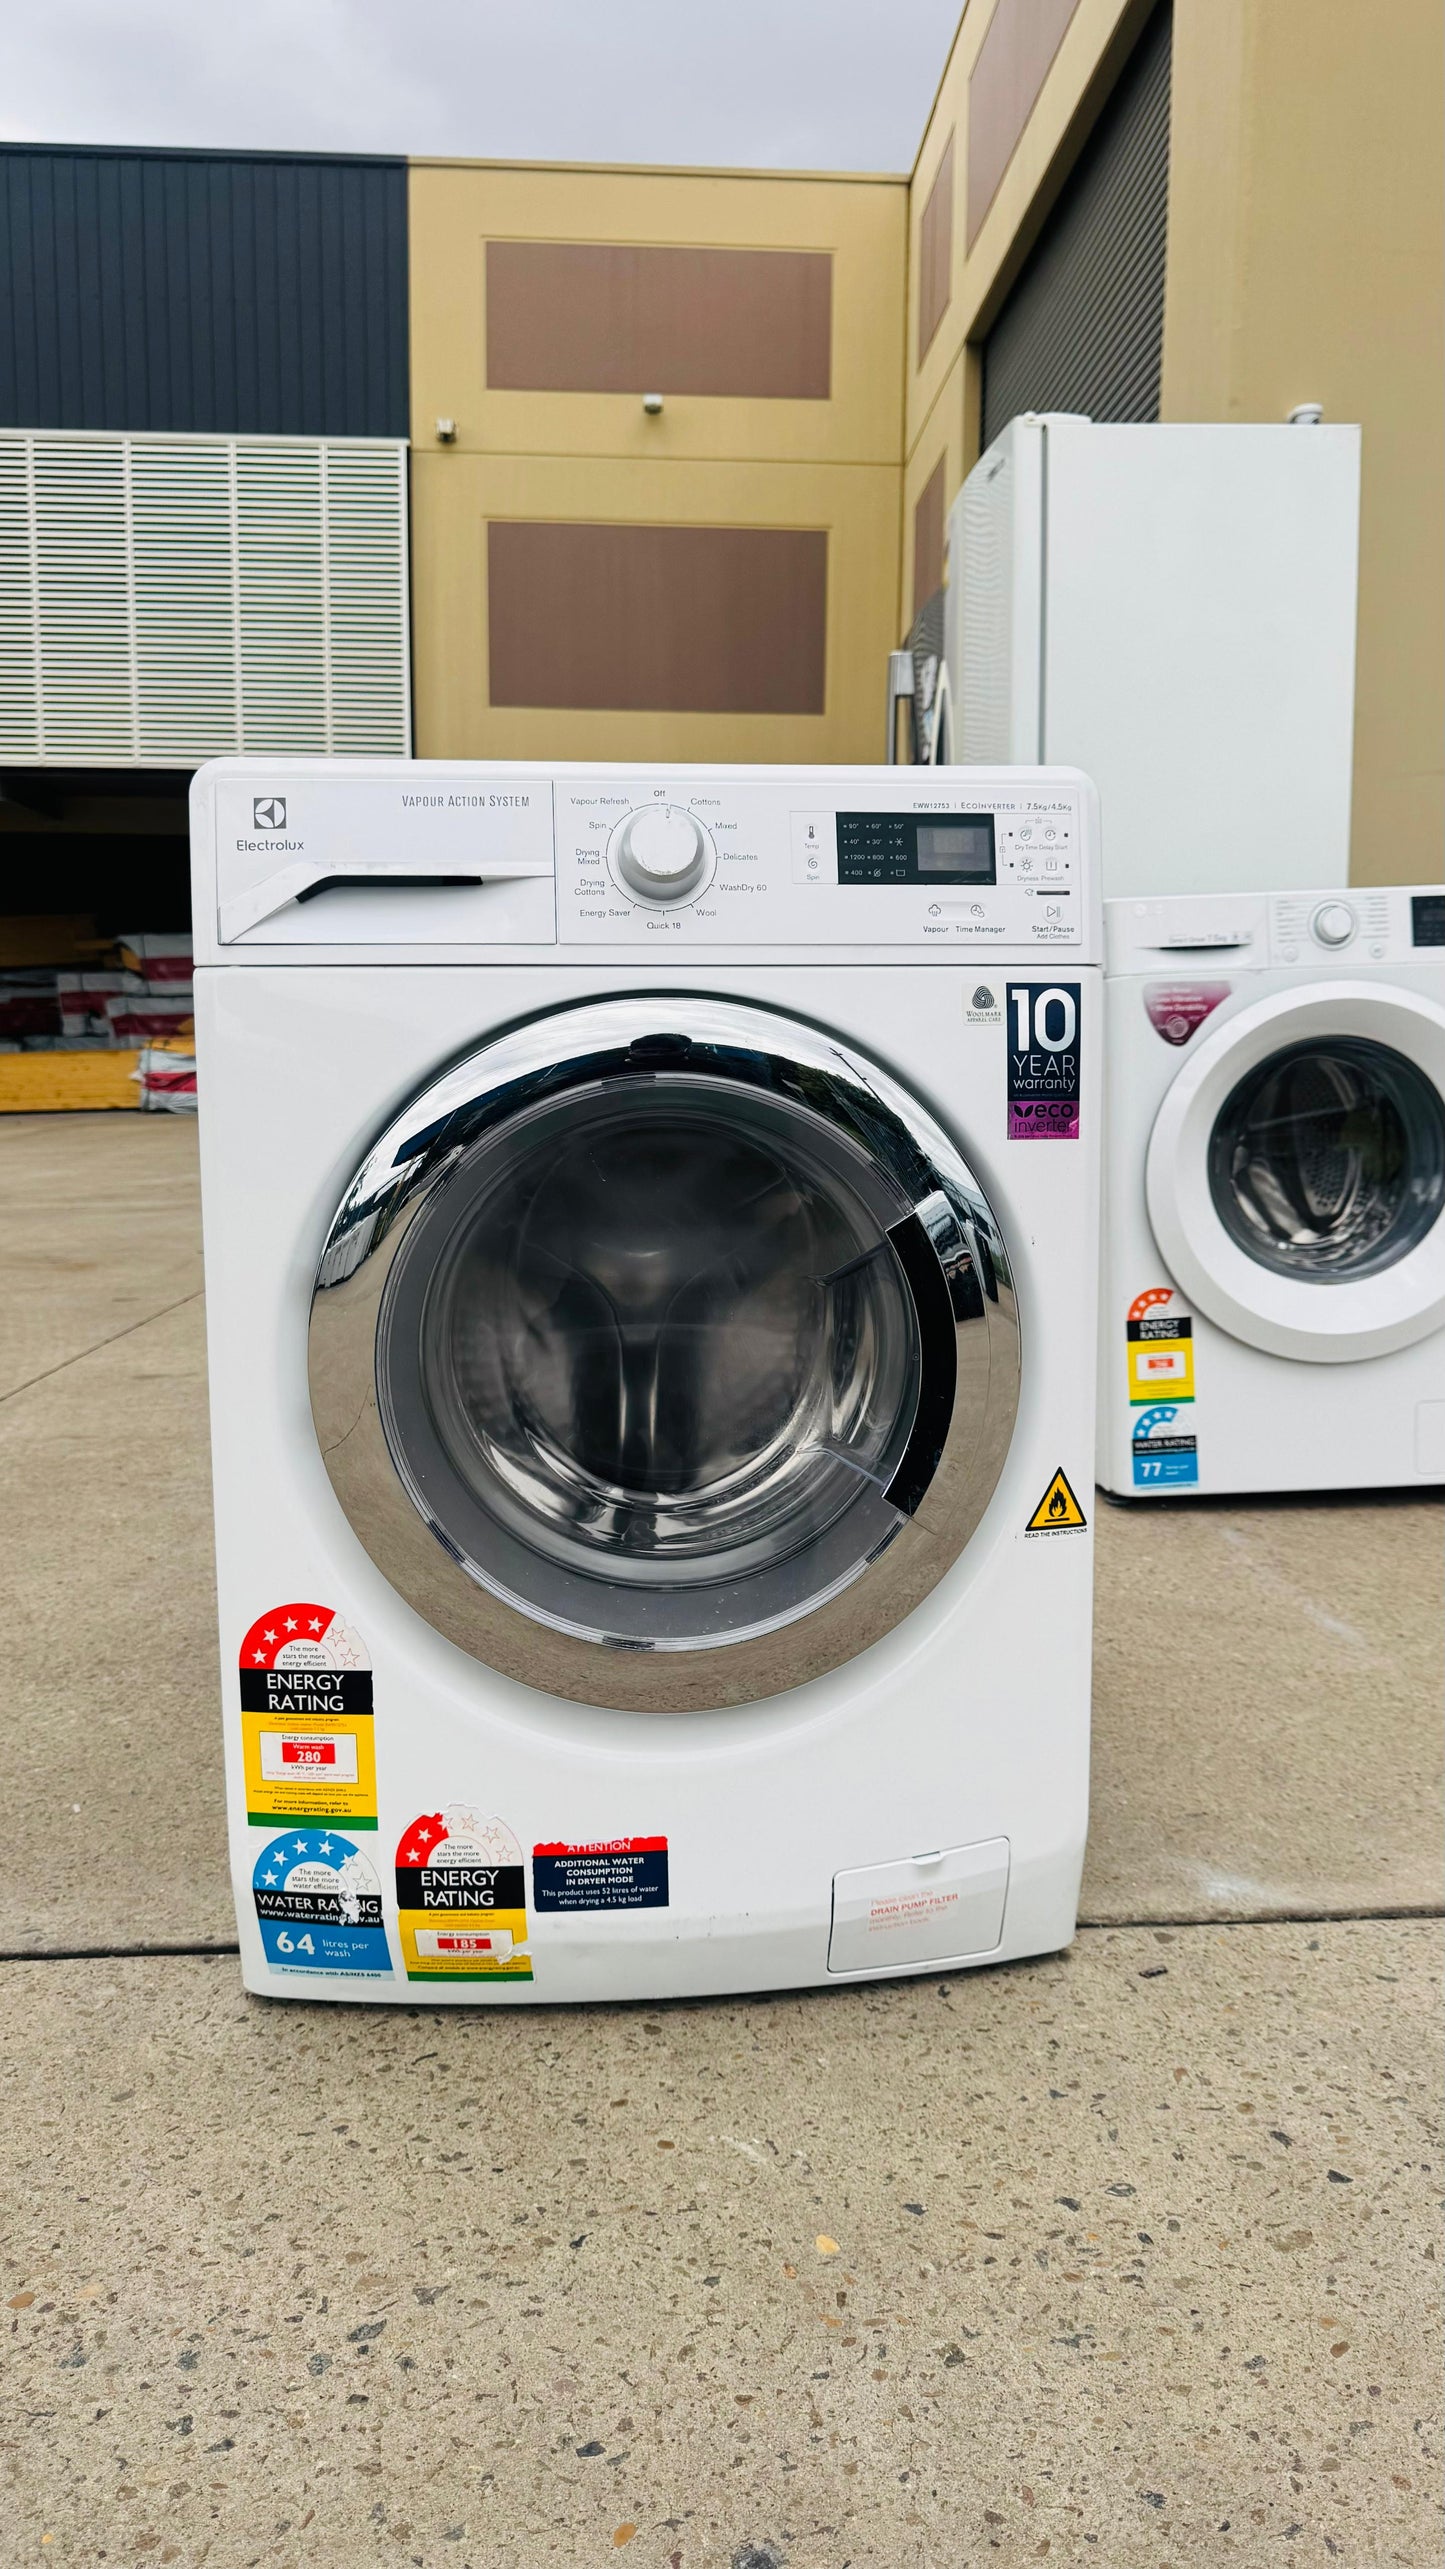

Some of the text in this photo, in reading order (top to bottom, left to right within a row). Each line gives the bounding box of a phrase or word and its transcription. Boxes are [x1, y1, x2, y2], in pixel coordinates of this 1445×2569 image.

[570, 798, 598, 806] Vapour
[588, 822, 606, 830] Spin
[236, 840, 304, 852] Electrolux
[575, 848, 600, 857] Drying
[580, 879, 605, 888] Drying
[719, 884, 754, 893] WashDry
[580, 909, 606, 918] Energy
[646, 922, 670, 930] Quick
[974, 926, 1006, 934] Manager
[1011, 988, 1076, 1052] 10
[1013, 1054, 1076, 1076] YEAR
[1013, 1076, 1076, 1092] warranty
[1034, 1104, 1074, 1118] eco
[1141, 1462, 1162, 1477] 77
[1052, 1528, 1088, 1537] INSTRUCTIONS
[266, 1673, 344, 1690] ENERGY
[268, 1694, 344, 1711] RATING
[297, 1751, 321, 1762] 280
[554, 1859, 610, 1868] ADDITIONAL
[567, 1867, 633, 1876] CONSUMPTION
[421, 1870, 499, 1886] ENERGY
[558, 1889, 584, 1897] product
[424, 1890, 494, 1906] RATING
[578, 1898, 599, 1906] drying
[258, 1894, 378, 1913] WATER RANG
[871, 1893, 958, 1916] DRAIN PUMP FILTER
[276, 1932, 315, 1955] 64
[322, 1940, 348, 1948] litres
[453, 1940, 477, 1948] 185
